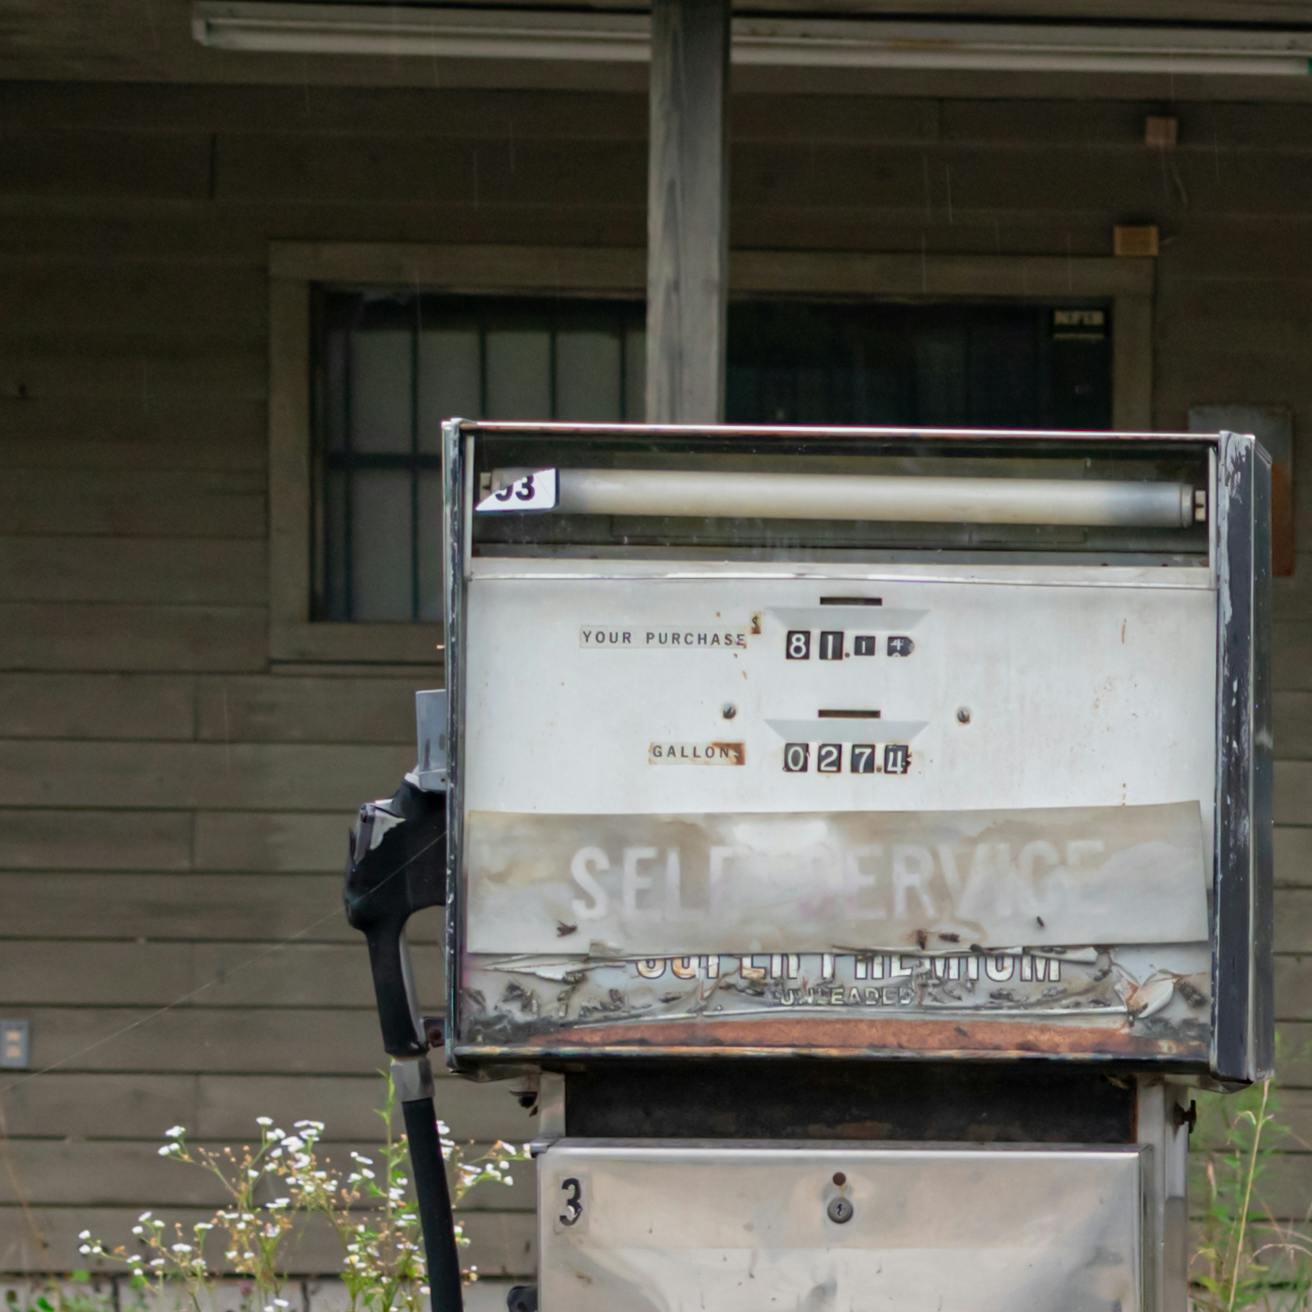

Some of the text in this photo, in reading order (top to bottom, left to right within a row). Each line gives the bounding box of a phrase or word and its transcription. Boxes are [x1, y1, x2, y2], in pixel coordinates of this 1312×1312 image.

[583, 631, 747, 646] YOUR PURCHASE
[559, 1178, 583, 1226] 3
